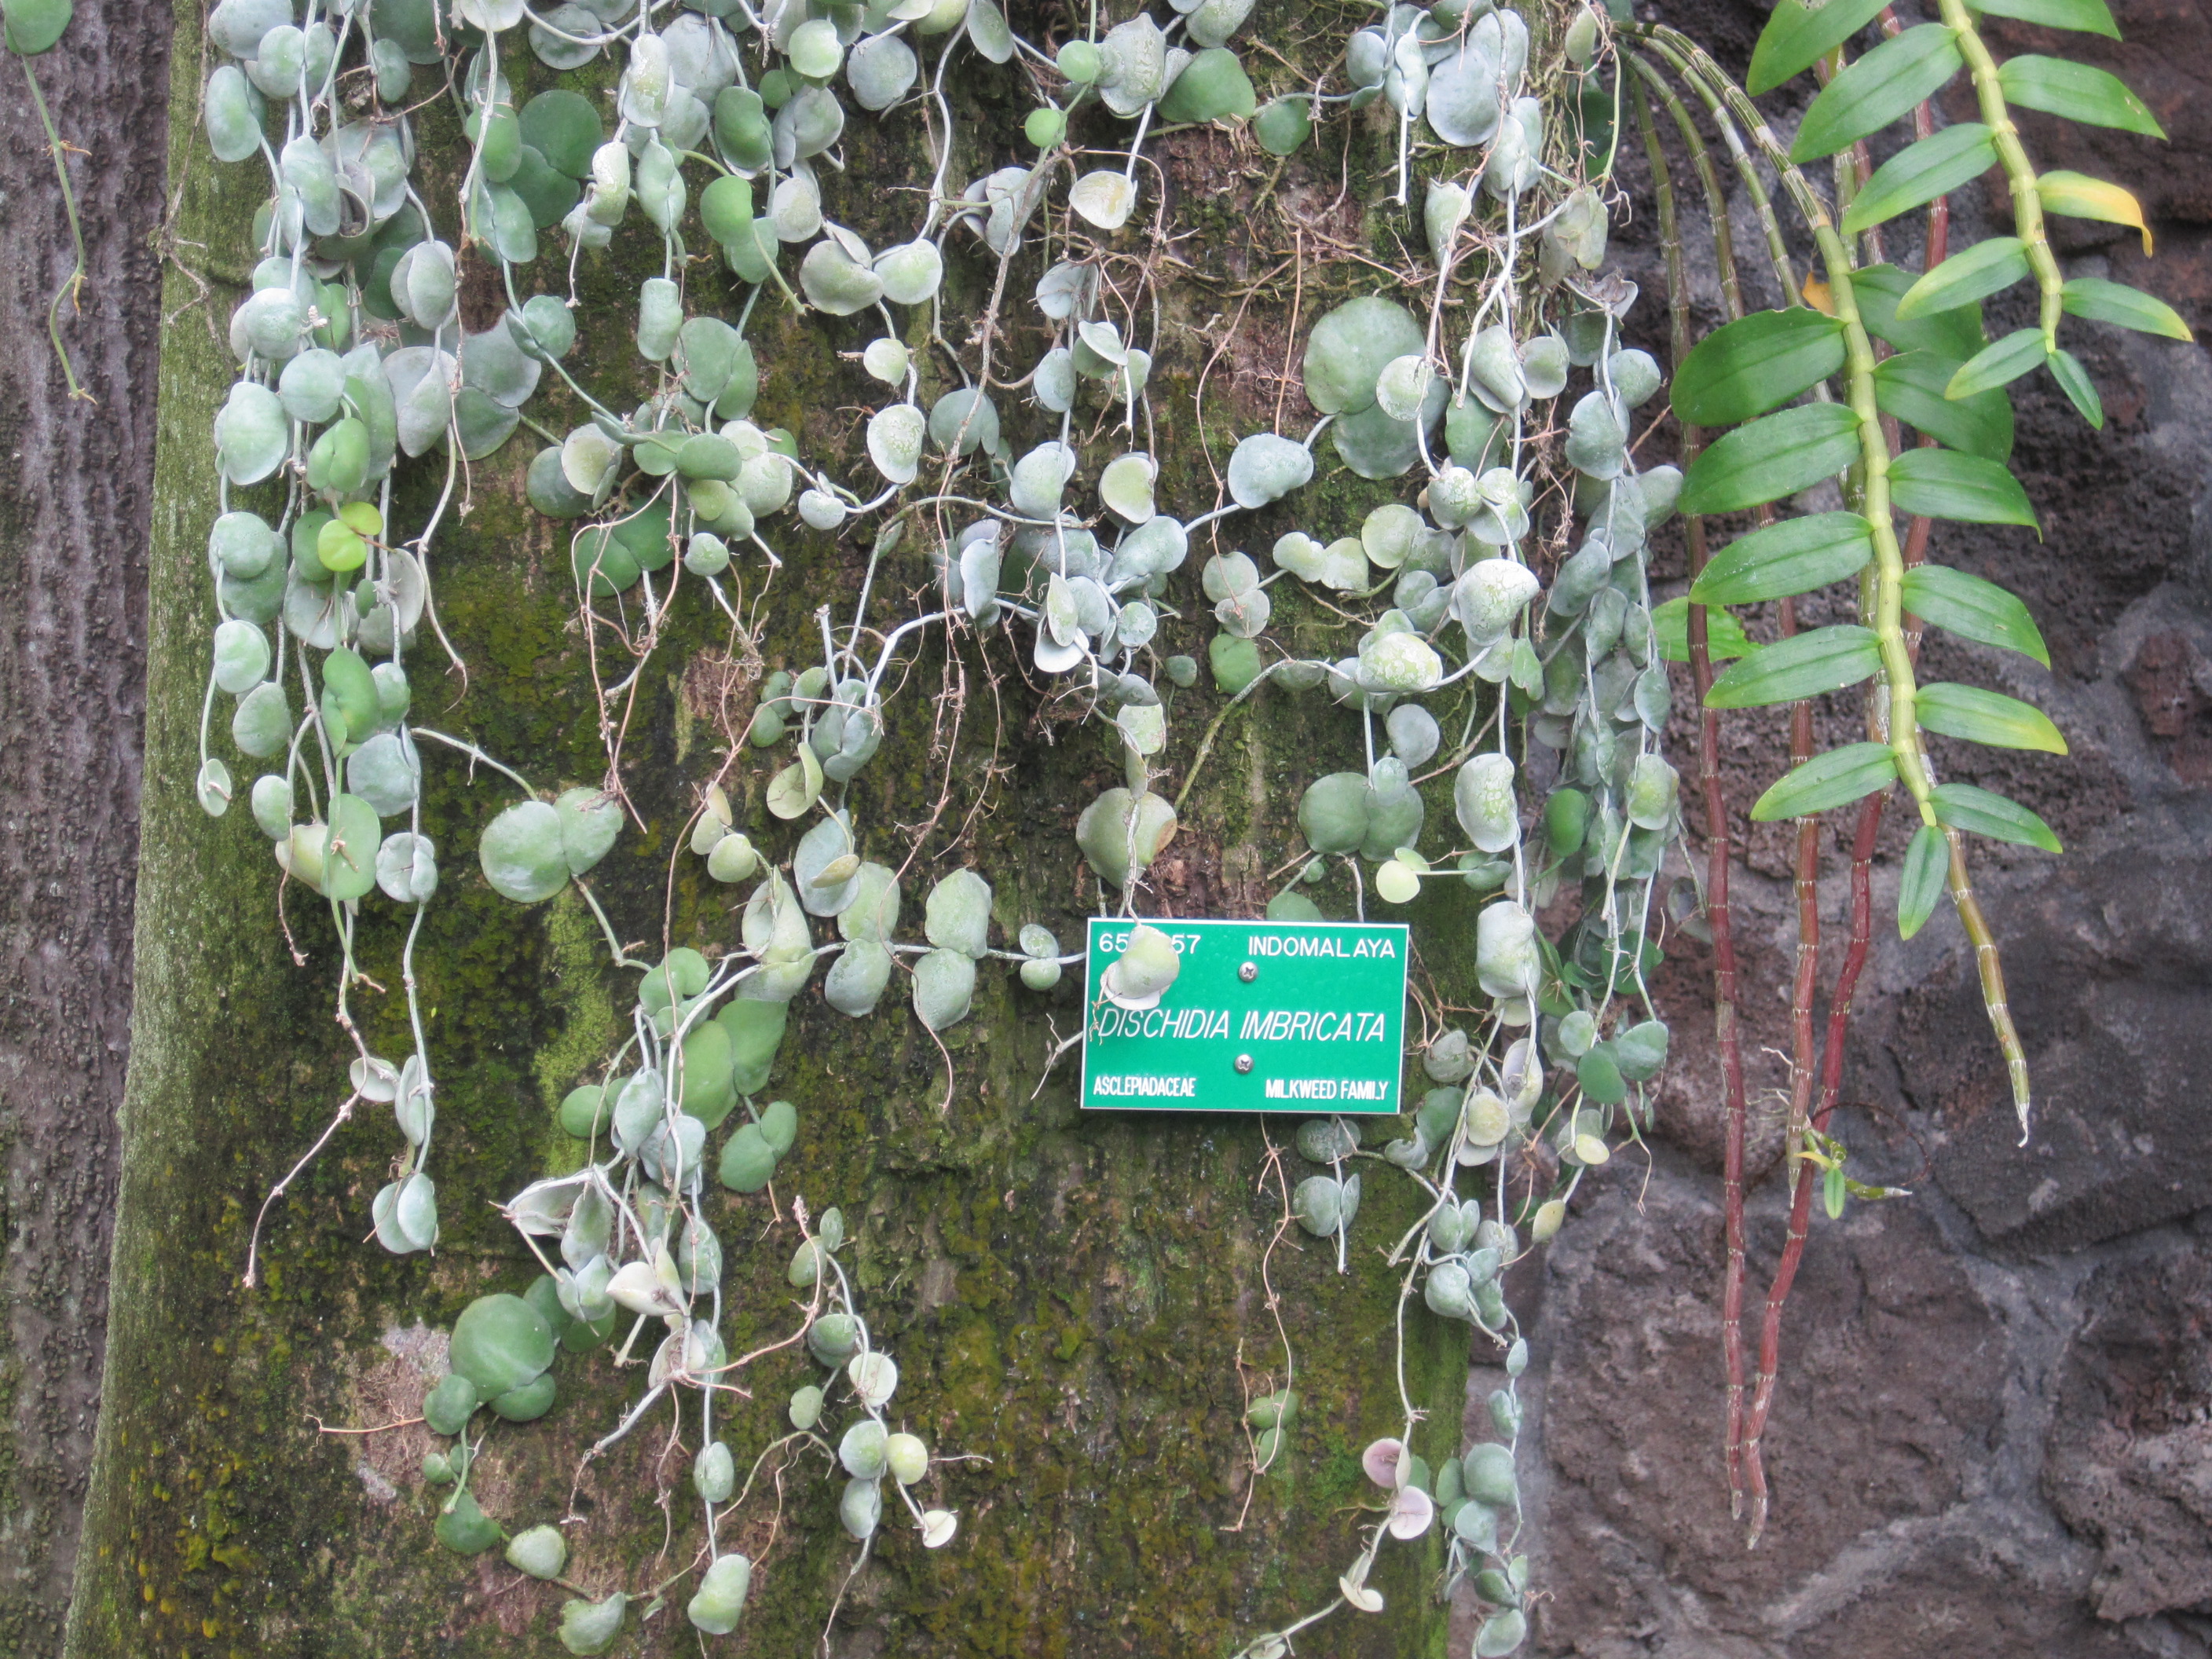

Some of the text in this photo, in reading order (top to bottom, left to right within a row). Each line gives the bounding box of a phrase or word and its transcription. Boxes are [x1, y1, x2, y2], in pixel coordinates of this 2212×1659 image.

[1099, 932, 1202, 954] 6557
[1248, 936, 1396, 958] INDOMALAYA
[1098, 1008, 1385, 1042] DISCHIDIA IMBRICATA
[1093, 1075, 1196, 1097] ASCLEPIADACEAE
[1265, 1079, 1389, 1101] MILKWEED FAMILY
